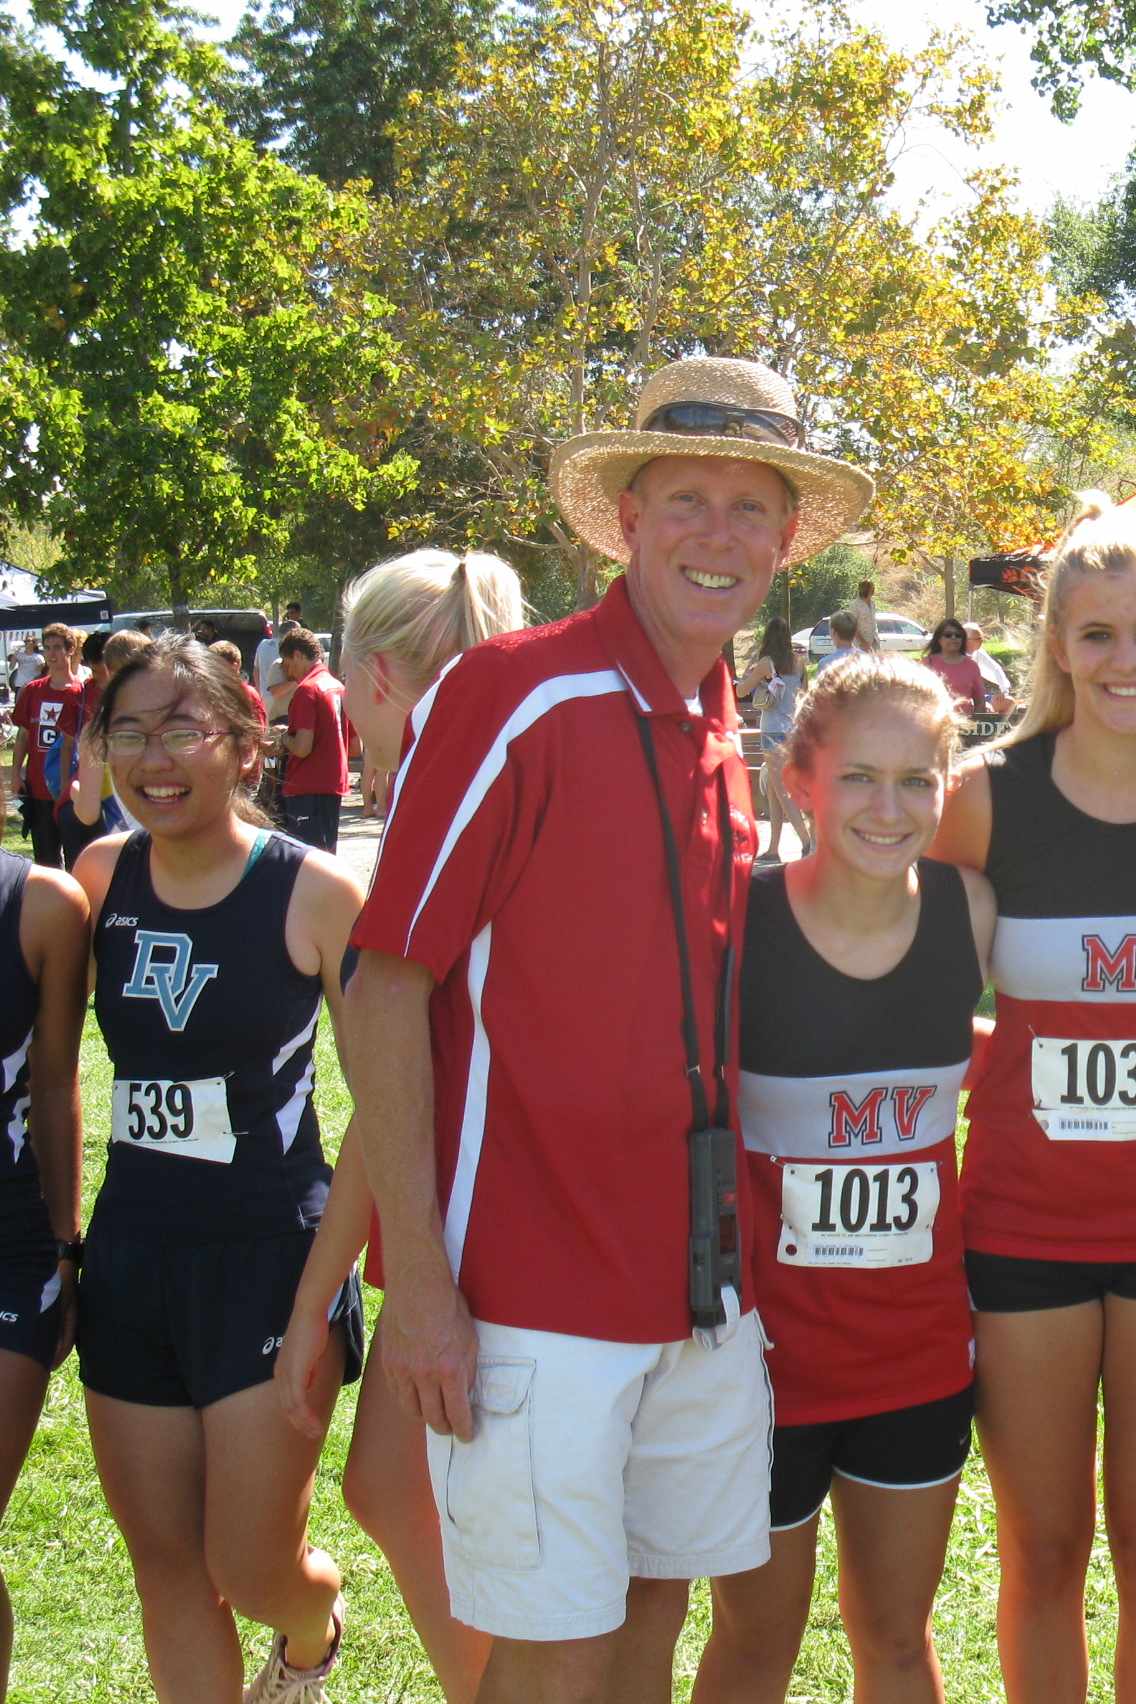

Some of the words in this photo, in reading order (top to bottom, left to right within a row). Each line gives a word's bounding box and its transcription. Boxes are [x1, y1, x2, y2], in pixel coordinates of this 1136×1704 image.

[122, 930, 219, 1031] DV
[128, 1082, 193, 1140] 539
[828, 1085, 938, 1148] MV
[811, 1167, 919, 1232] 1013
